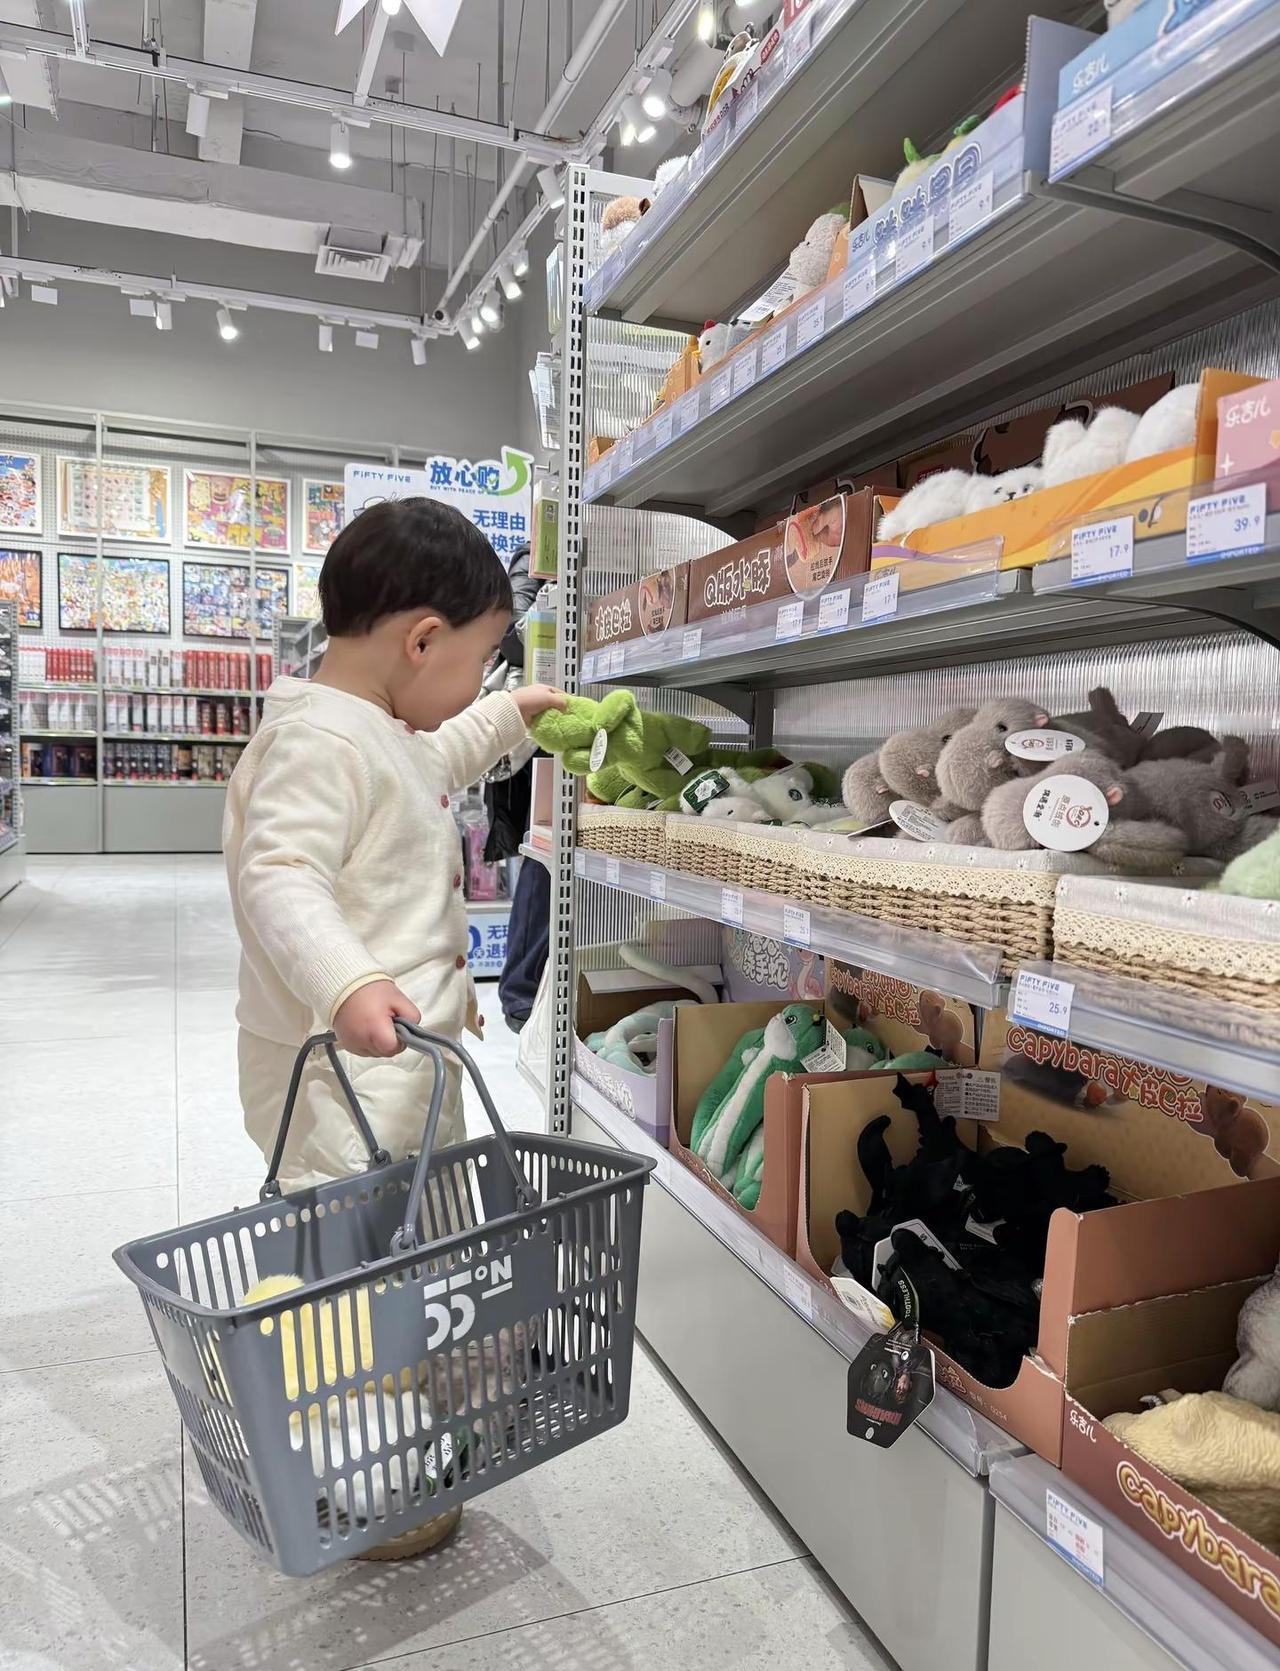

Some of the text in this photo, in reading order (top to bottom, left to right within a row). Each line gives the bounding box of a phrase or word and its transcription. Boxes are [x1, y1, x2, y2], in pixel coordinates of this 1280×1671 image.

[430, 461, 500, 490] 放心购
[473, 509, 526, 532] 无理由
[485, 533, 526, 554] 换货
[1049, 1001, 1068, 1014] 25.9
[1007, 1026, 1122, 1092] Capybara
